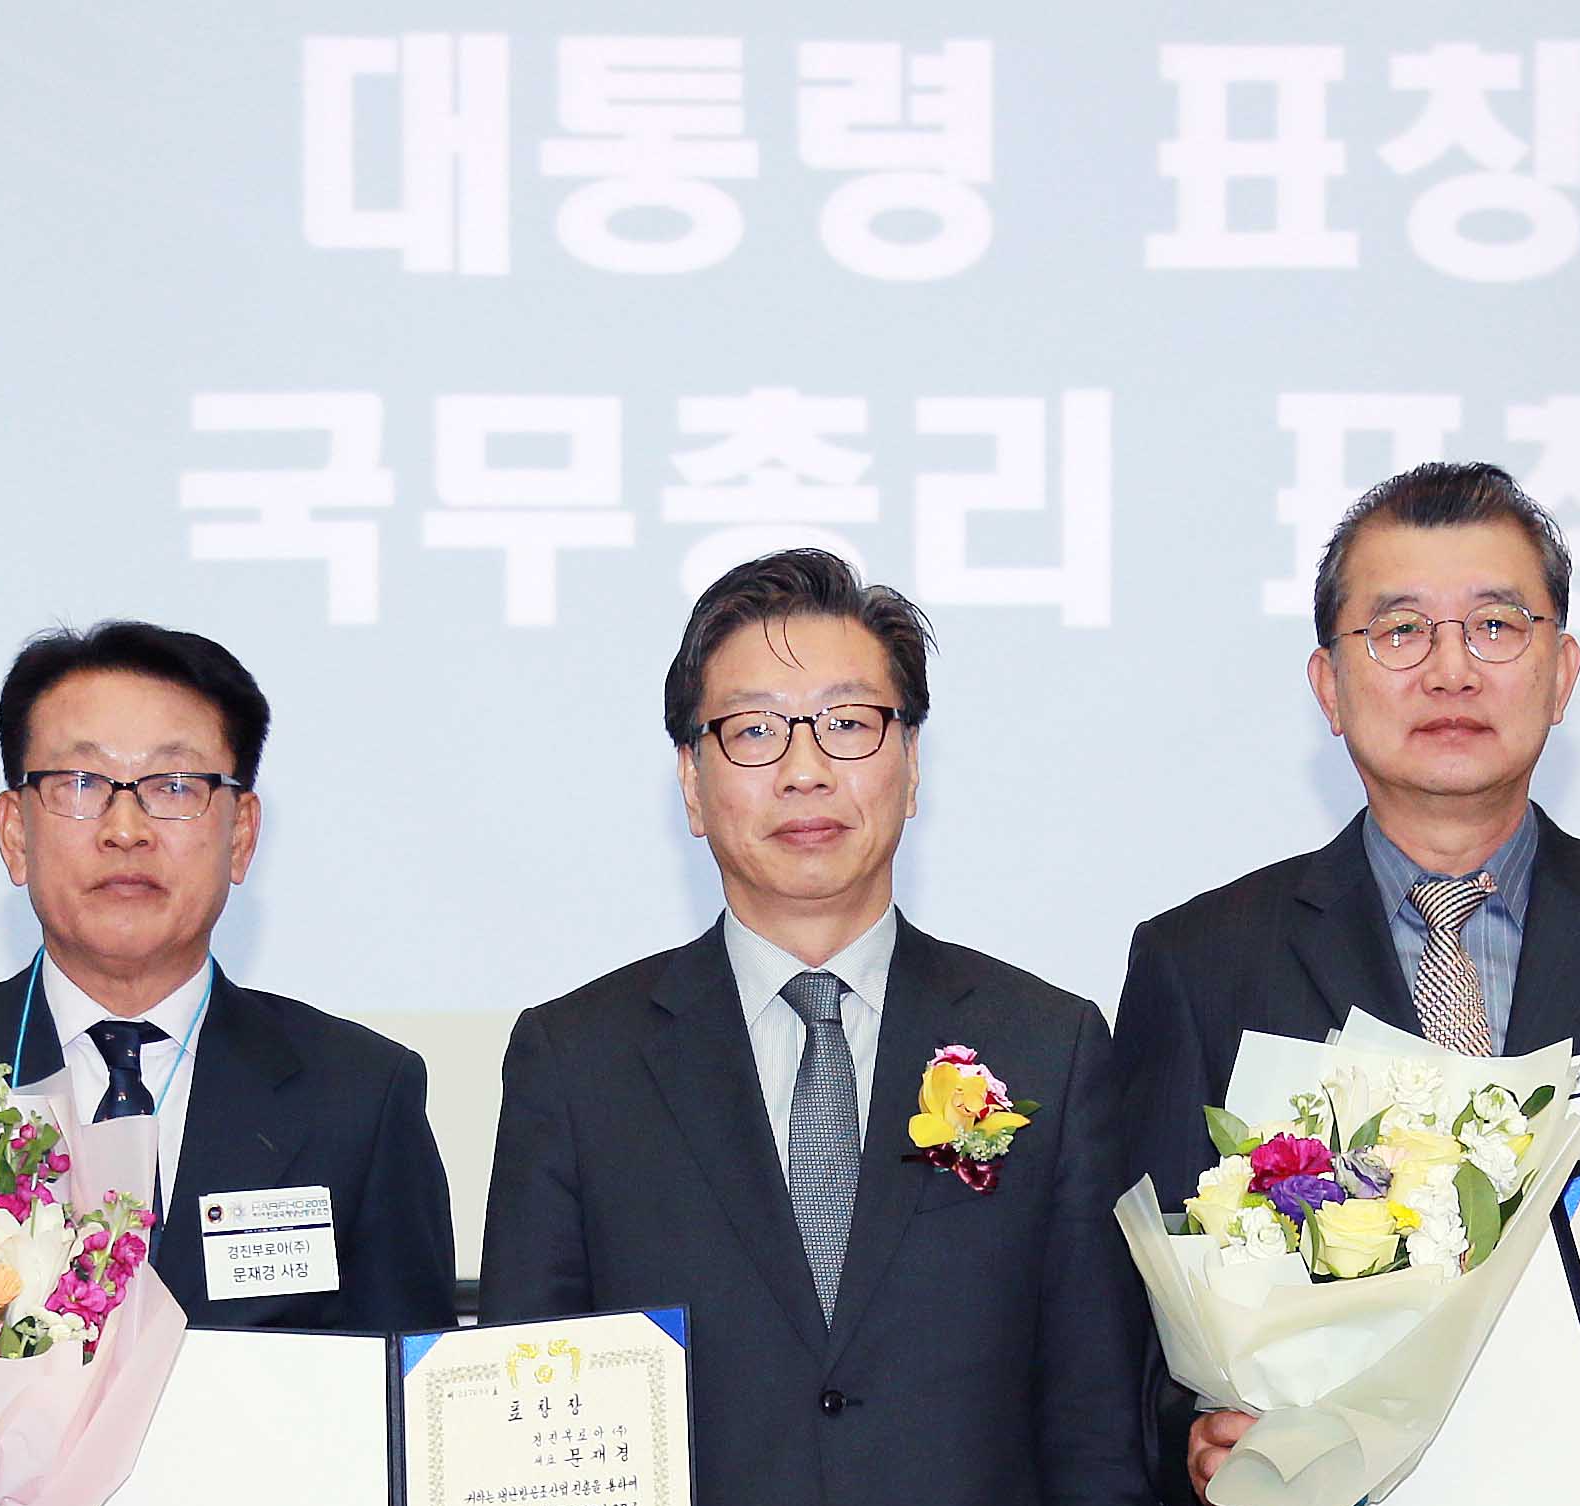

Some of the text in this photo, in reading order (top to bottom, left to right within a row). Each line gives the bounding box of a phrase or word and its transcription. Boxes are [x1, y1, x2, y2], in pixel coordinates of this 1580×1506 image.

[301, 33, 997, 281] 대통령
[178, 386, 1114, 628] 국무총리
[305, 1199, 329, 1208] 2019
[227, 1240, 310, 1260] 경진부로아(주)
[232, 1262, 309, 1283] 문재경 사장
